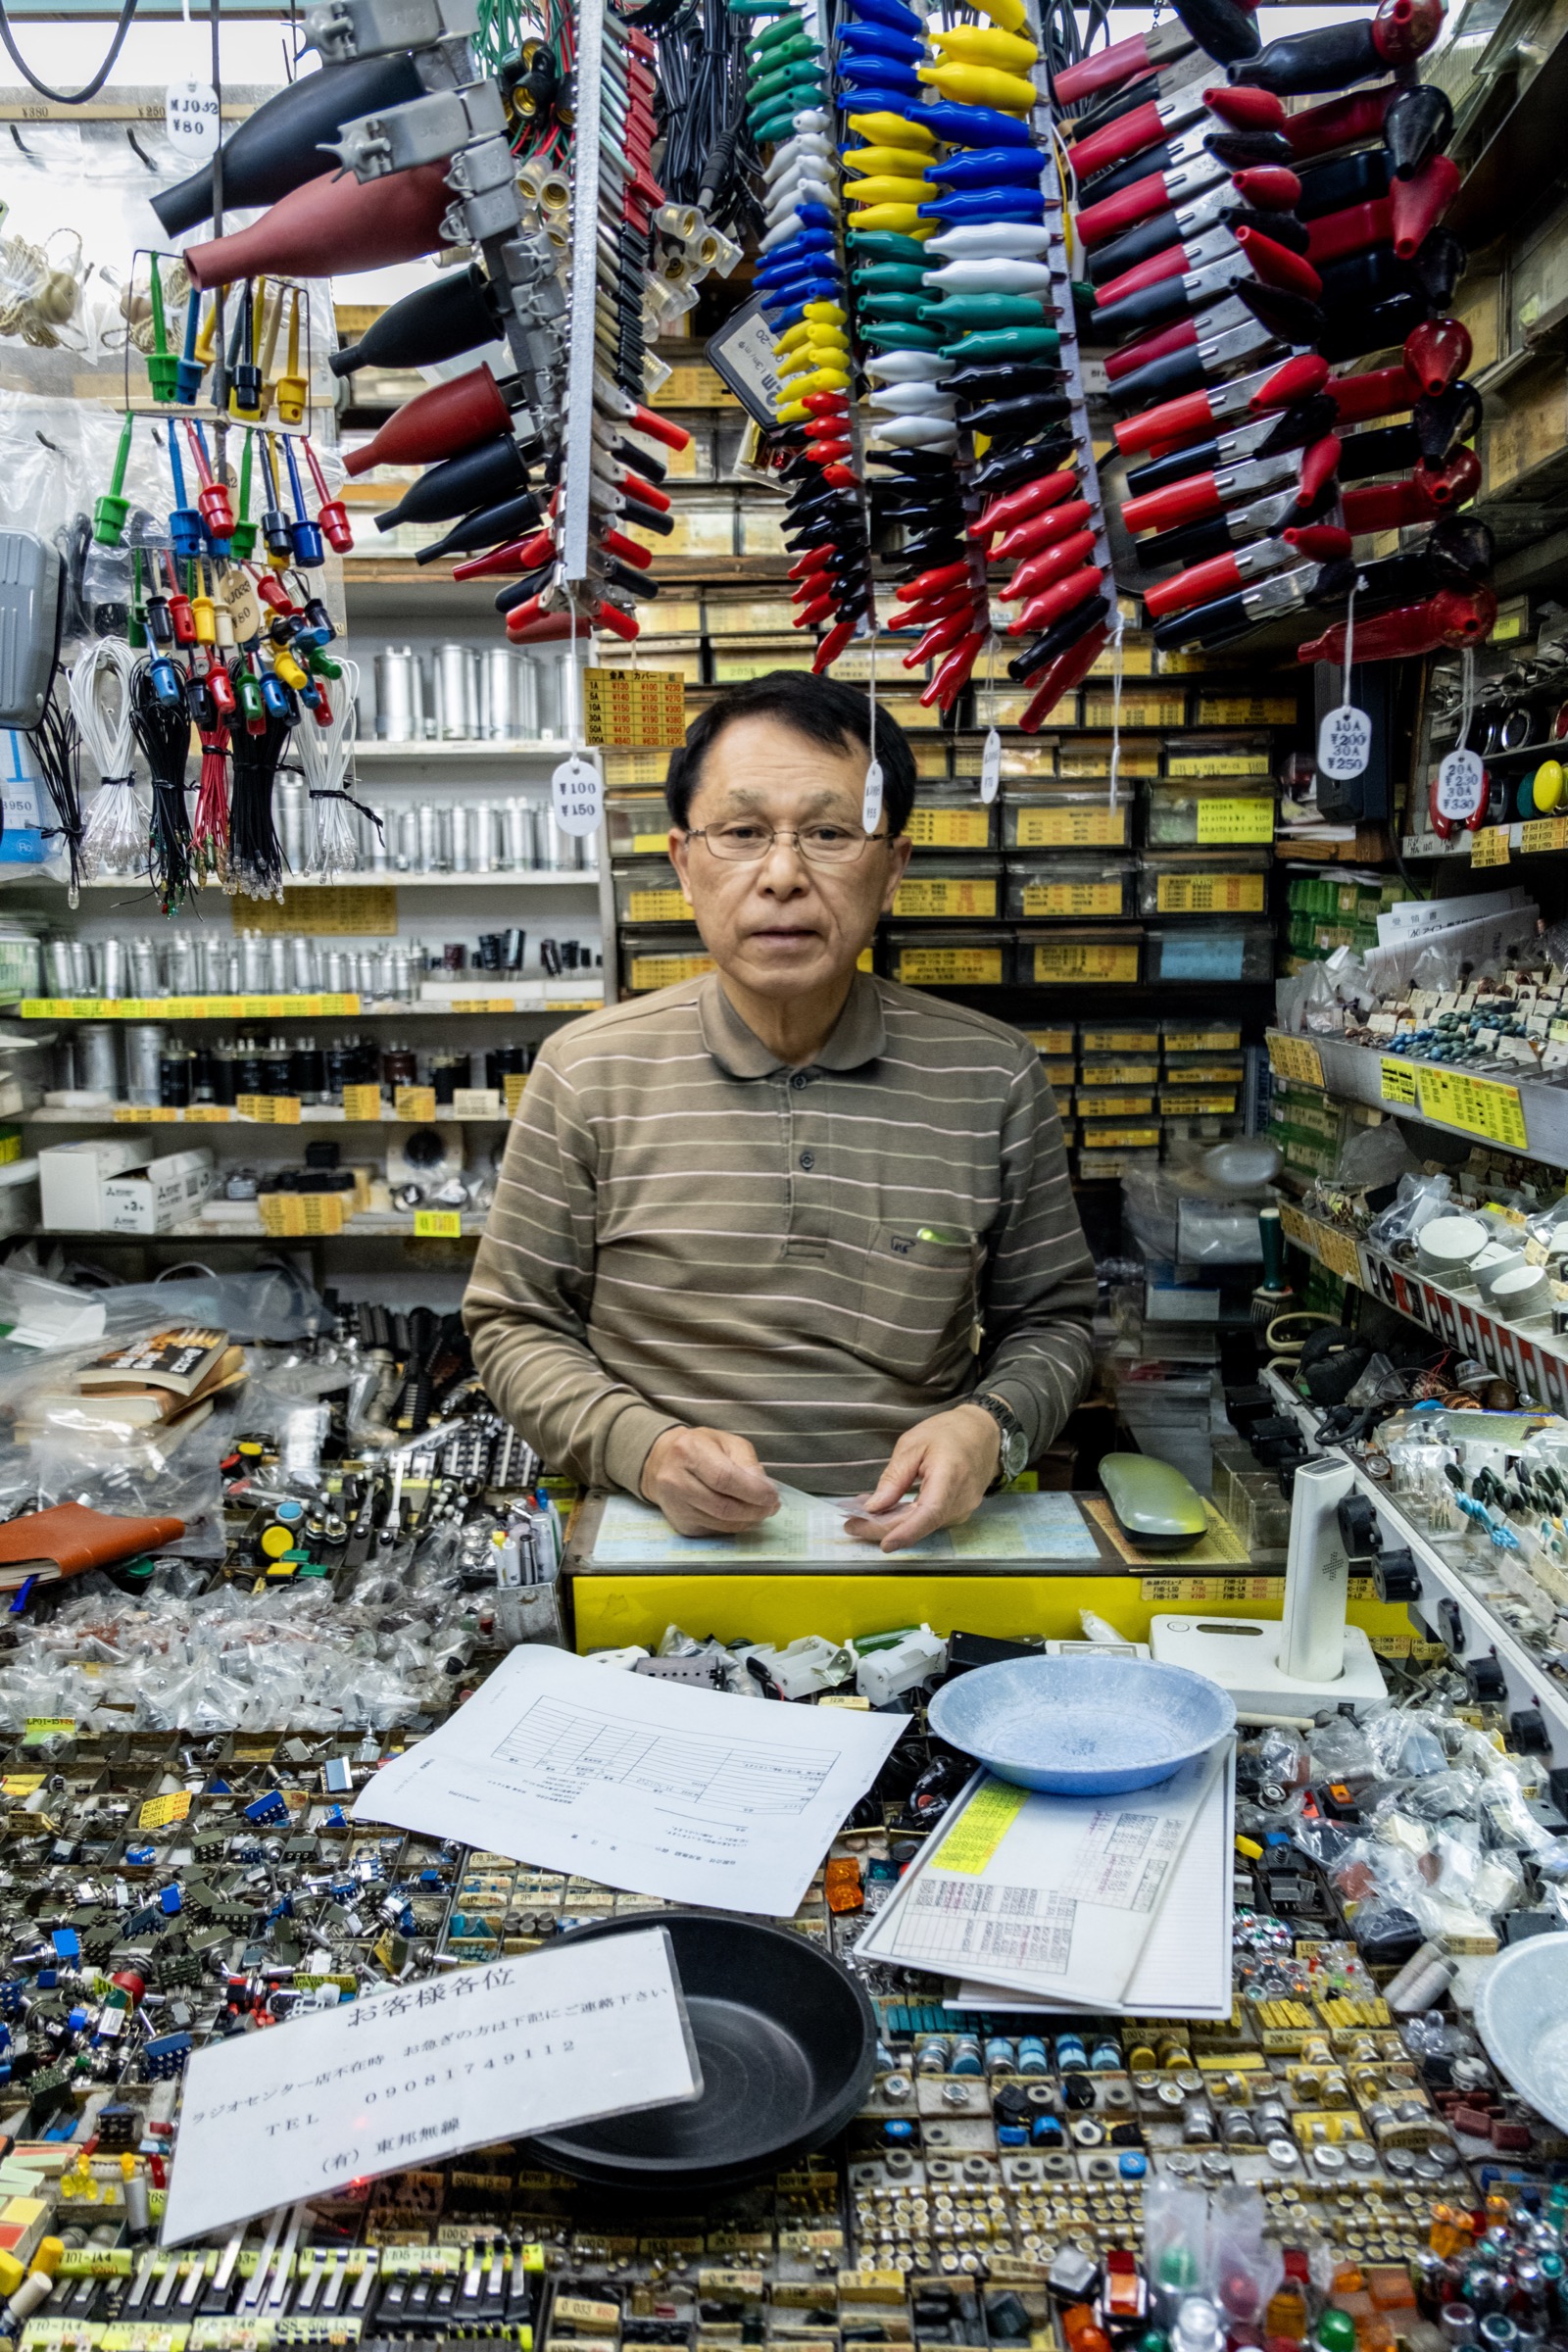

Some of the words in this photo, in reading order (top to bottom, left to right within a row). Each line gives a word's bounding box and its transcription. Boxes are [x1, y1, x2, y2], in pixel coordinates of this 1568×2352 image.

[23, 107, 49, 119] ¥380
[173, 120, 205, 135] ¥80
[1335, 720, 1362, 732] 10A
[588, 736, 605, 745] 100A
[1331, 734, 1366, 746] ¥200
[1333, 746, 1360, 757] 30A
[1327, 759, 1363, 770] ¥250
[1447, 764, 1472, 775] 20A
[560, 783, 596, 795] ¥100
[1447, 786, 1472, 797] 30A
[562, 805, 596, 816] ¥150
[348, 1967, 515, 2028] お客様各位
[192, 2054, 385, 2125] ラジオセンター店不在時
[403, 1987, 668, 2057] お急ぎの方は下記にご連絡下さい
[266, 2113, 319, 2136] TEL
[375, 2117, 462, 2154] 東邦無線
